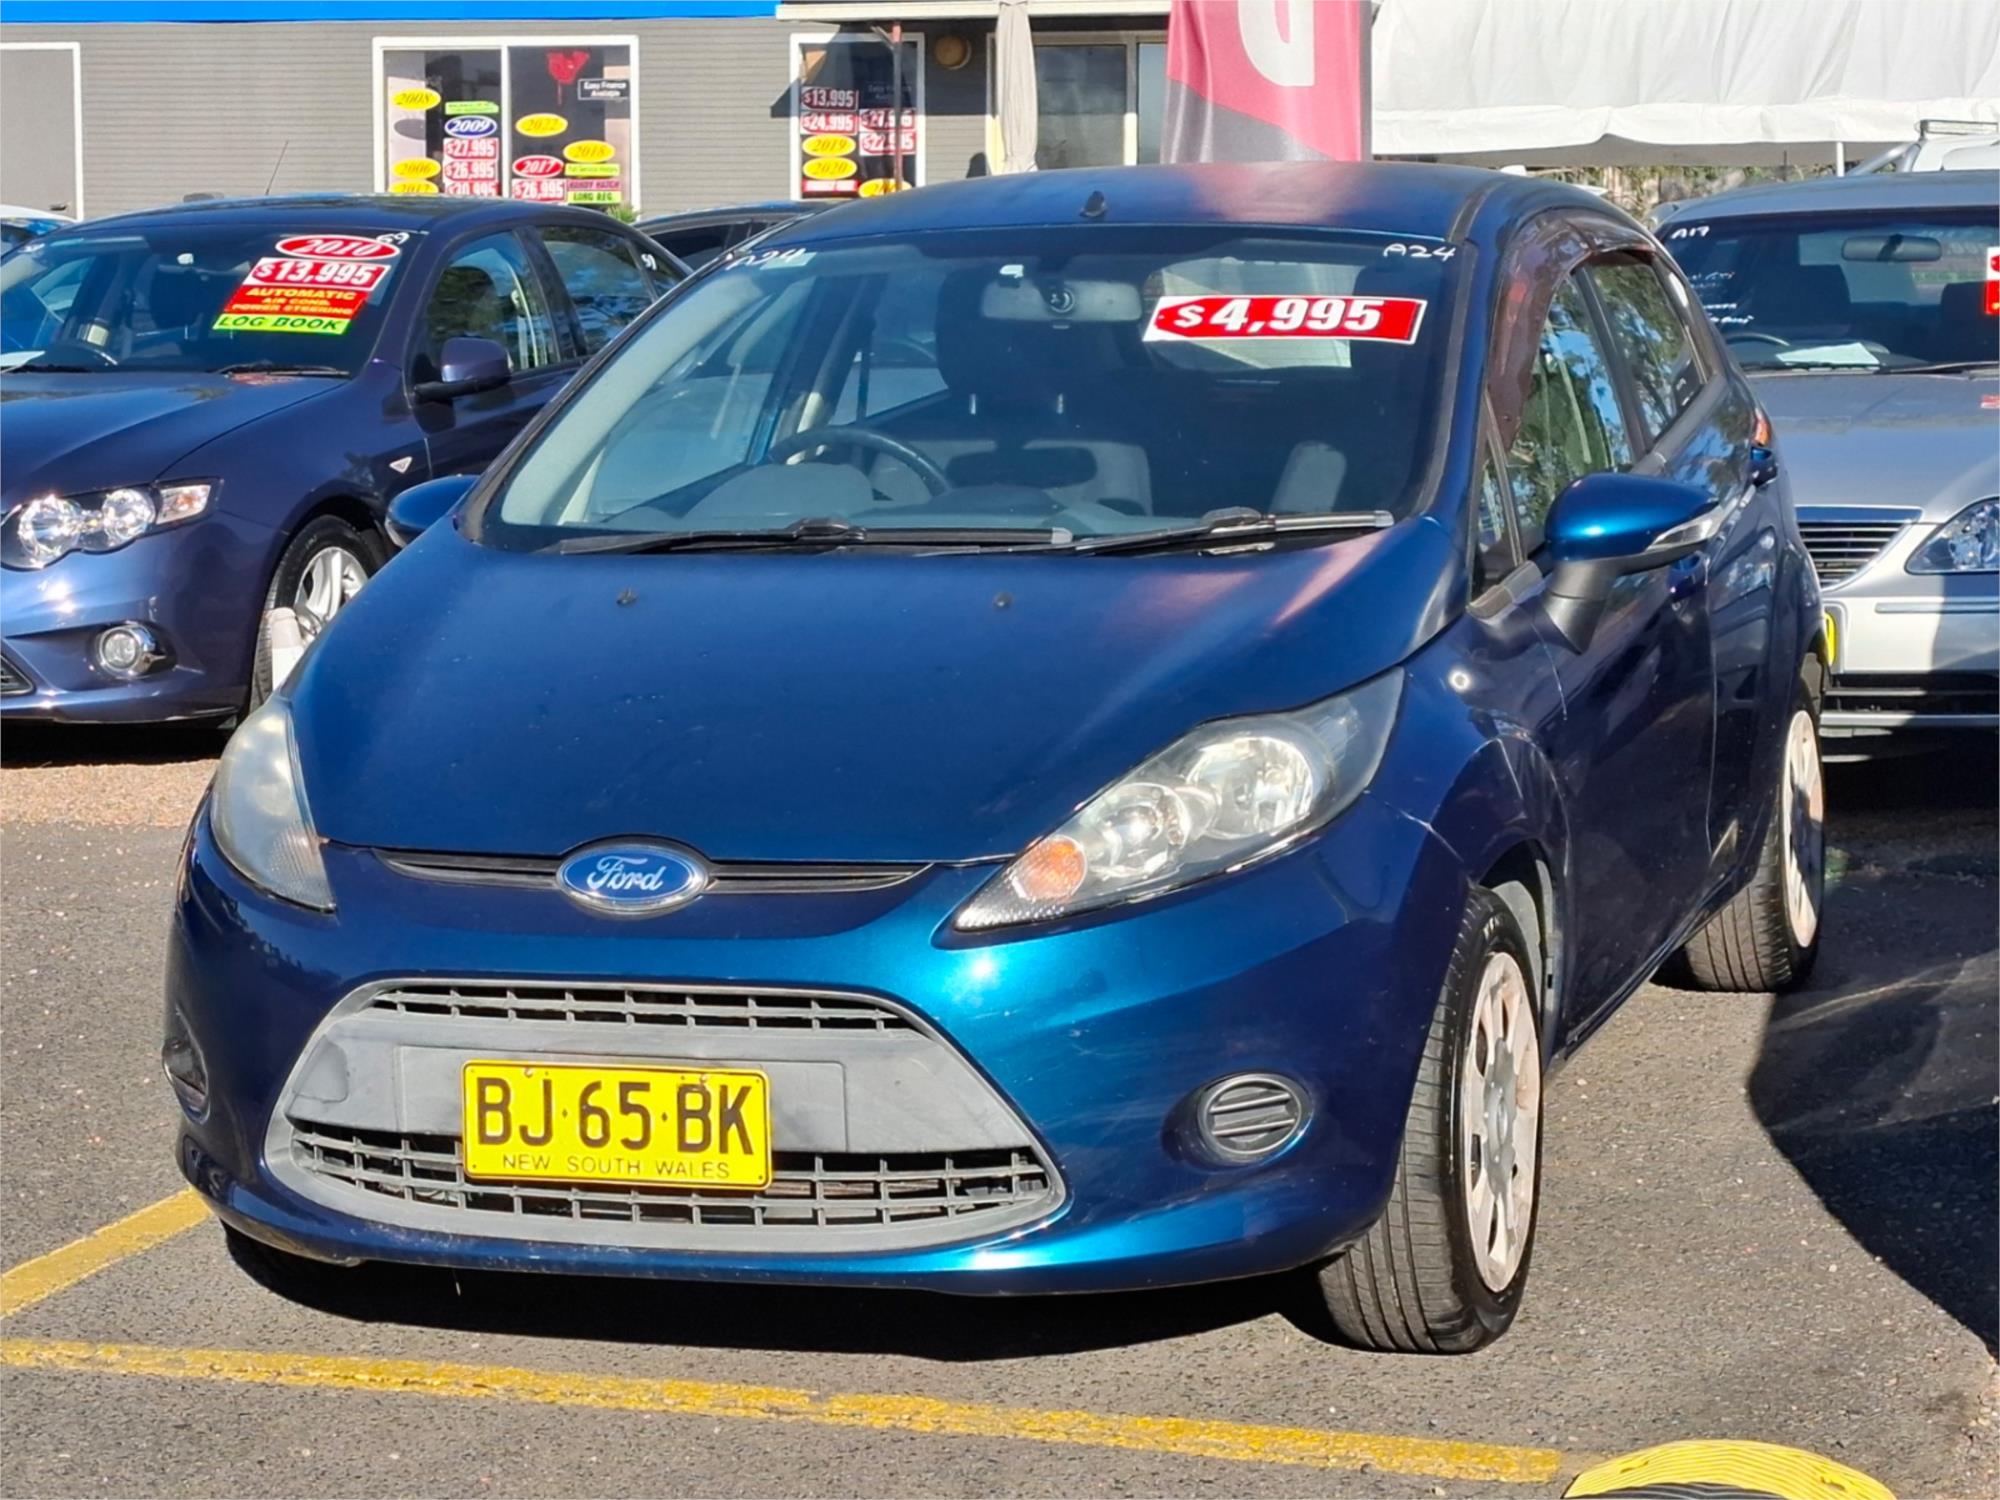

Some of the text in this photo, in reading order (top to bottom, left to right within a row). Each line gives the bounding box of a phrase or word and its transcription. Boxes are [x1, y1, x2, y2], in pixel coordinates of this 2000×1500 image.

[803, 89, 853, 107] $13,995
[450, 119, 492, 132] 2009
[803, 114, 853, 131] $24,995
[861, 110, 913, 128] $27,95
[446, 139, 495, 157] $27,995
[862, 133, 913, 150] $22,95
[444, 161, 494, 178] $26,995
[522, 160, 558, 174] 2017
[513, 180, 564, 199] $26,995
[573, 193, 593, 201] LONG
[292, 239, 381, 256] 2010
[1383, 243, 1456, 261] A24
[255, 262, 373, 284] $13,995
[246, 287, 357, 301] AUTOMATIC
[261, 297, 286, 305] AIR
[231, 304, 353, 315] POWER STEERING
[1173, 299, 1385, 333] $4,995
[218, 316, 343, 331] LOG BOOK
[586, 855, 667, 891] Ford
[503, 1154, 731, 1179] NEW SOUTH WALES
